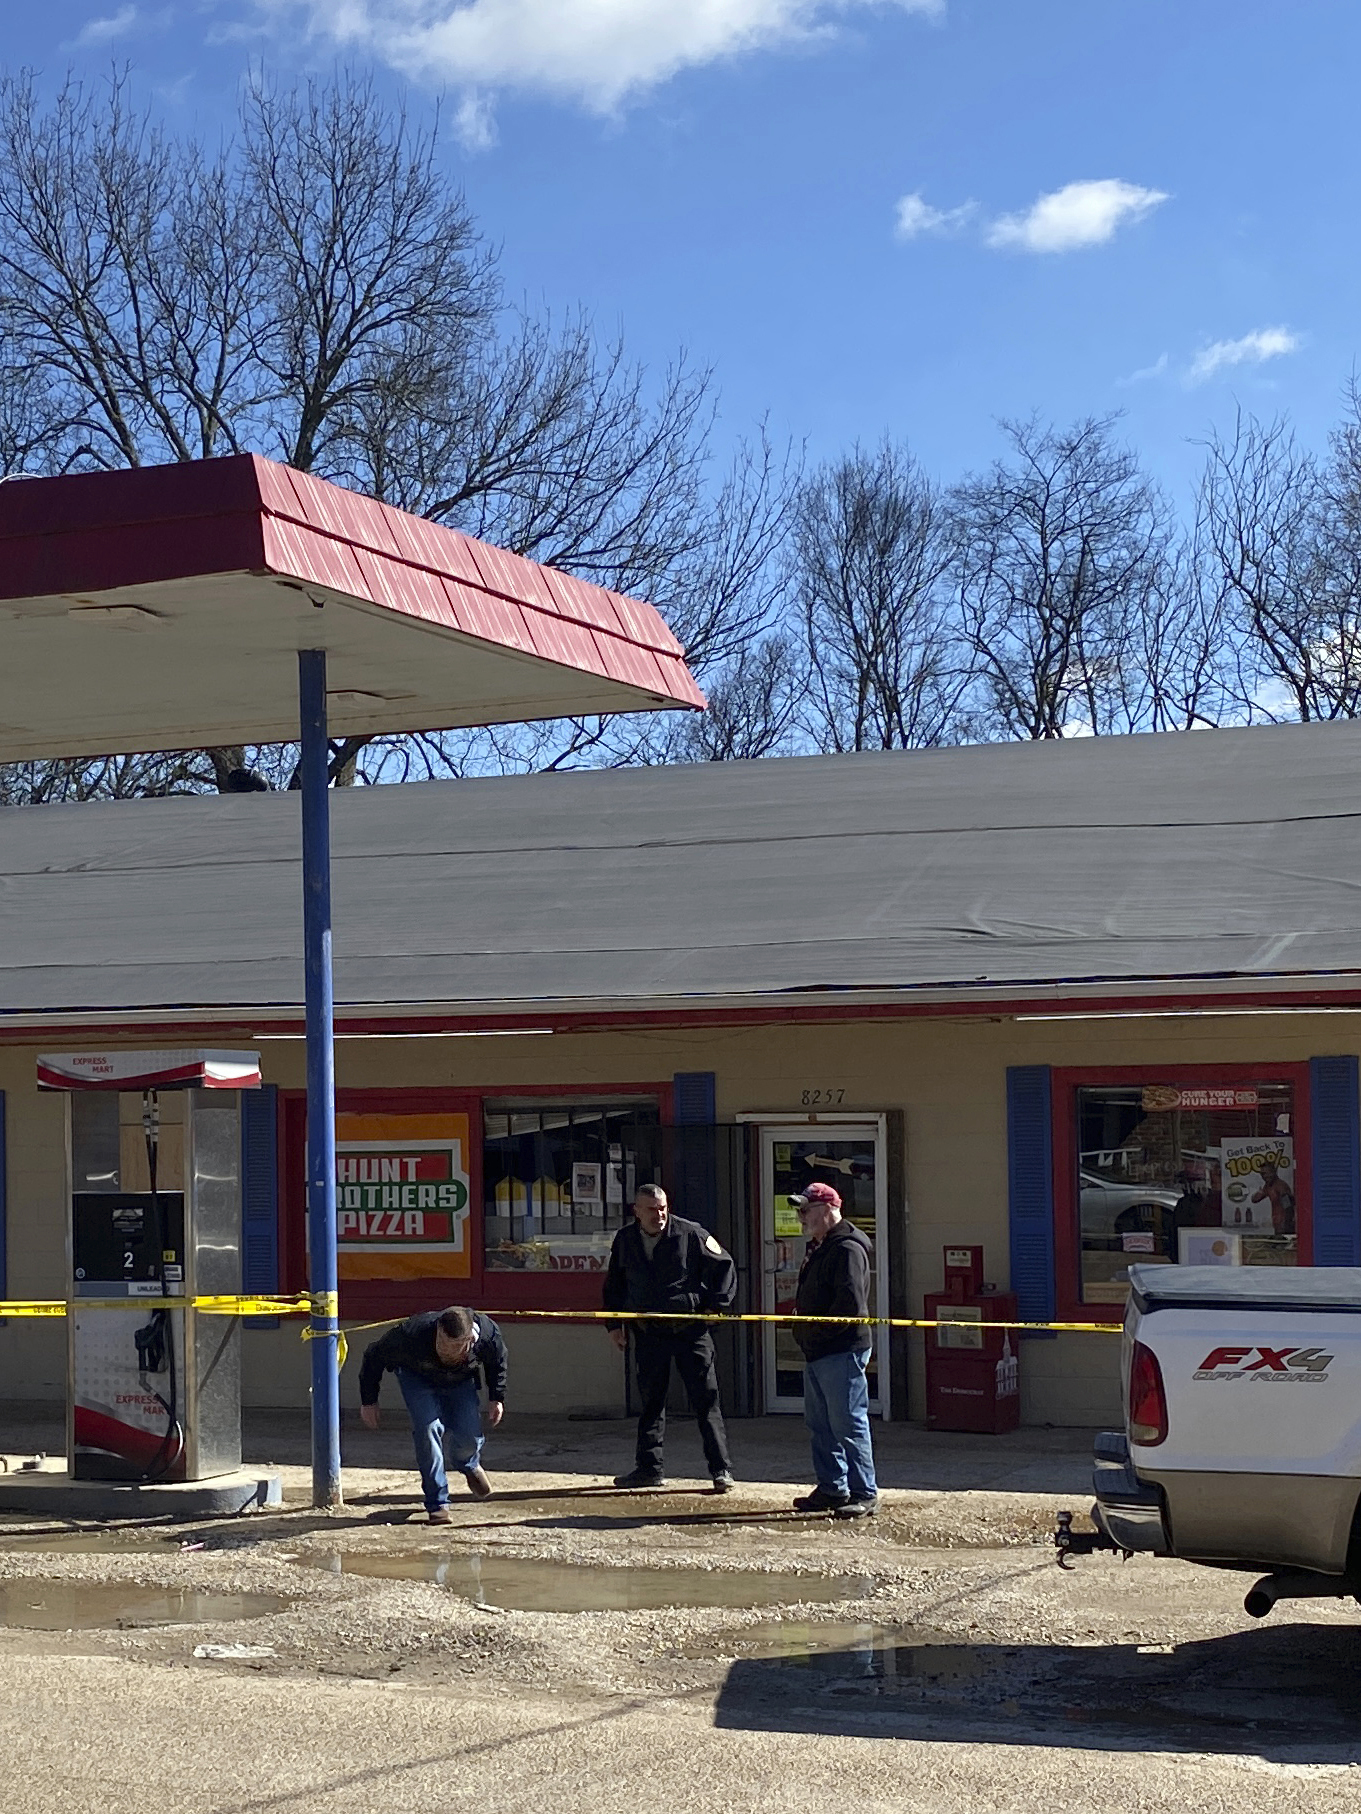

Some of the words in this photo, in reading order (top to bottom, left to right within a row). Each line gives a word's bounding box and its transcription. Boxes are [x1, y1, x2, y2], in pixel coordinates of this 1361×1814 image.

[72, 1057, 107, 1065] EXPRESS
[92, 1065, 114, 1073] MART
[801, 1088, 846, 1106] 8257
[1181, 1090, 1207, 1098] CURE
[1209, 1090, 1235, 1098] YOUR
[1181, 1097, 1235, 1106] HUNGER
[1227, 1146, 1244, 1157] Get
[1246, 1142, 1271, 1155] Back
[1273, 1140, 1285, 1150] To
[338, 1157, 422, 1183] HUNT
[1225, 1149, 1290, 1177] 100%
[336, 1184, 458, 1208] OTHERS
[337, 1210, 424, 1235] PIZZA
[123, 1252, 134, 1268] 2
[1197, 1346, 1335, 1372] FX4
[1192, 1371, 1247, 1381] OFF
[1250, 1372, 1329, 1383] ROAD
[143, 1406, 167, 1415] MAR
